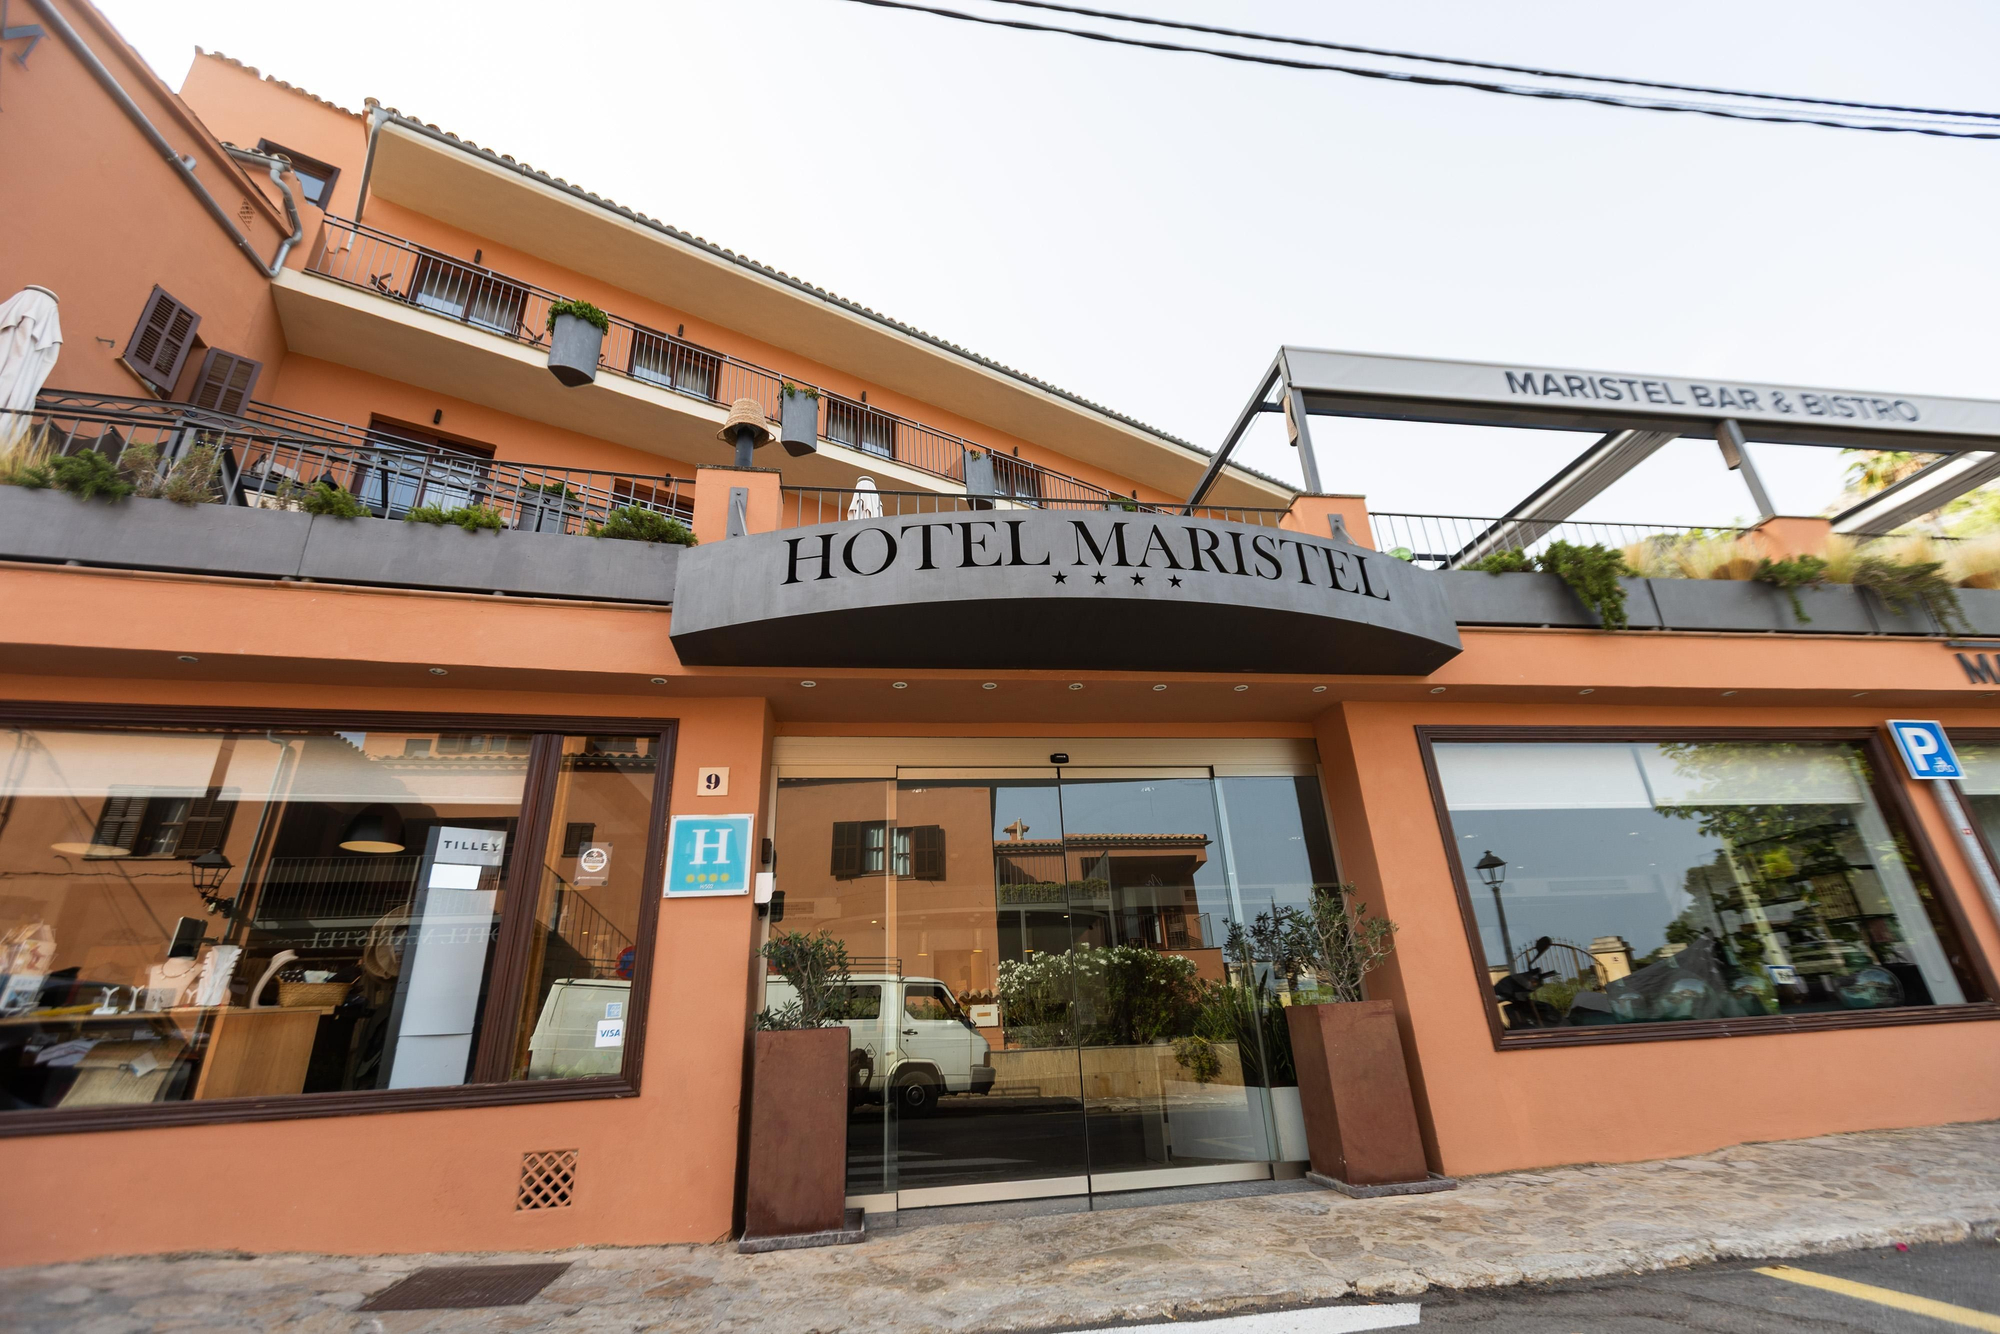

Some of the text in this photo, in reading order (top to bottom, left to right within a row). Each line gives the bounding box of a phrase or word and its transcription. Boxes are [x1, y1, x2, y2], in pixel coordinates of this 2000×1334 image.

[1504, 370, 1921, 423] MARISTEL BAR & BISTRO
[780, 520, 1391, 602] HOTEL MARISTEL
[1898, 727, 1939, 771] P
[705, 773, 721, 790] 9
[443, 840, 501, 852] TILLEY
[689, 828, 733, 865] H
[600, 1029, 620, 1038] VISA
